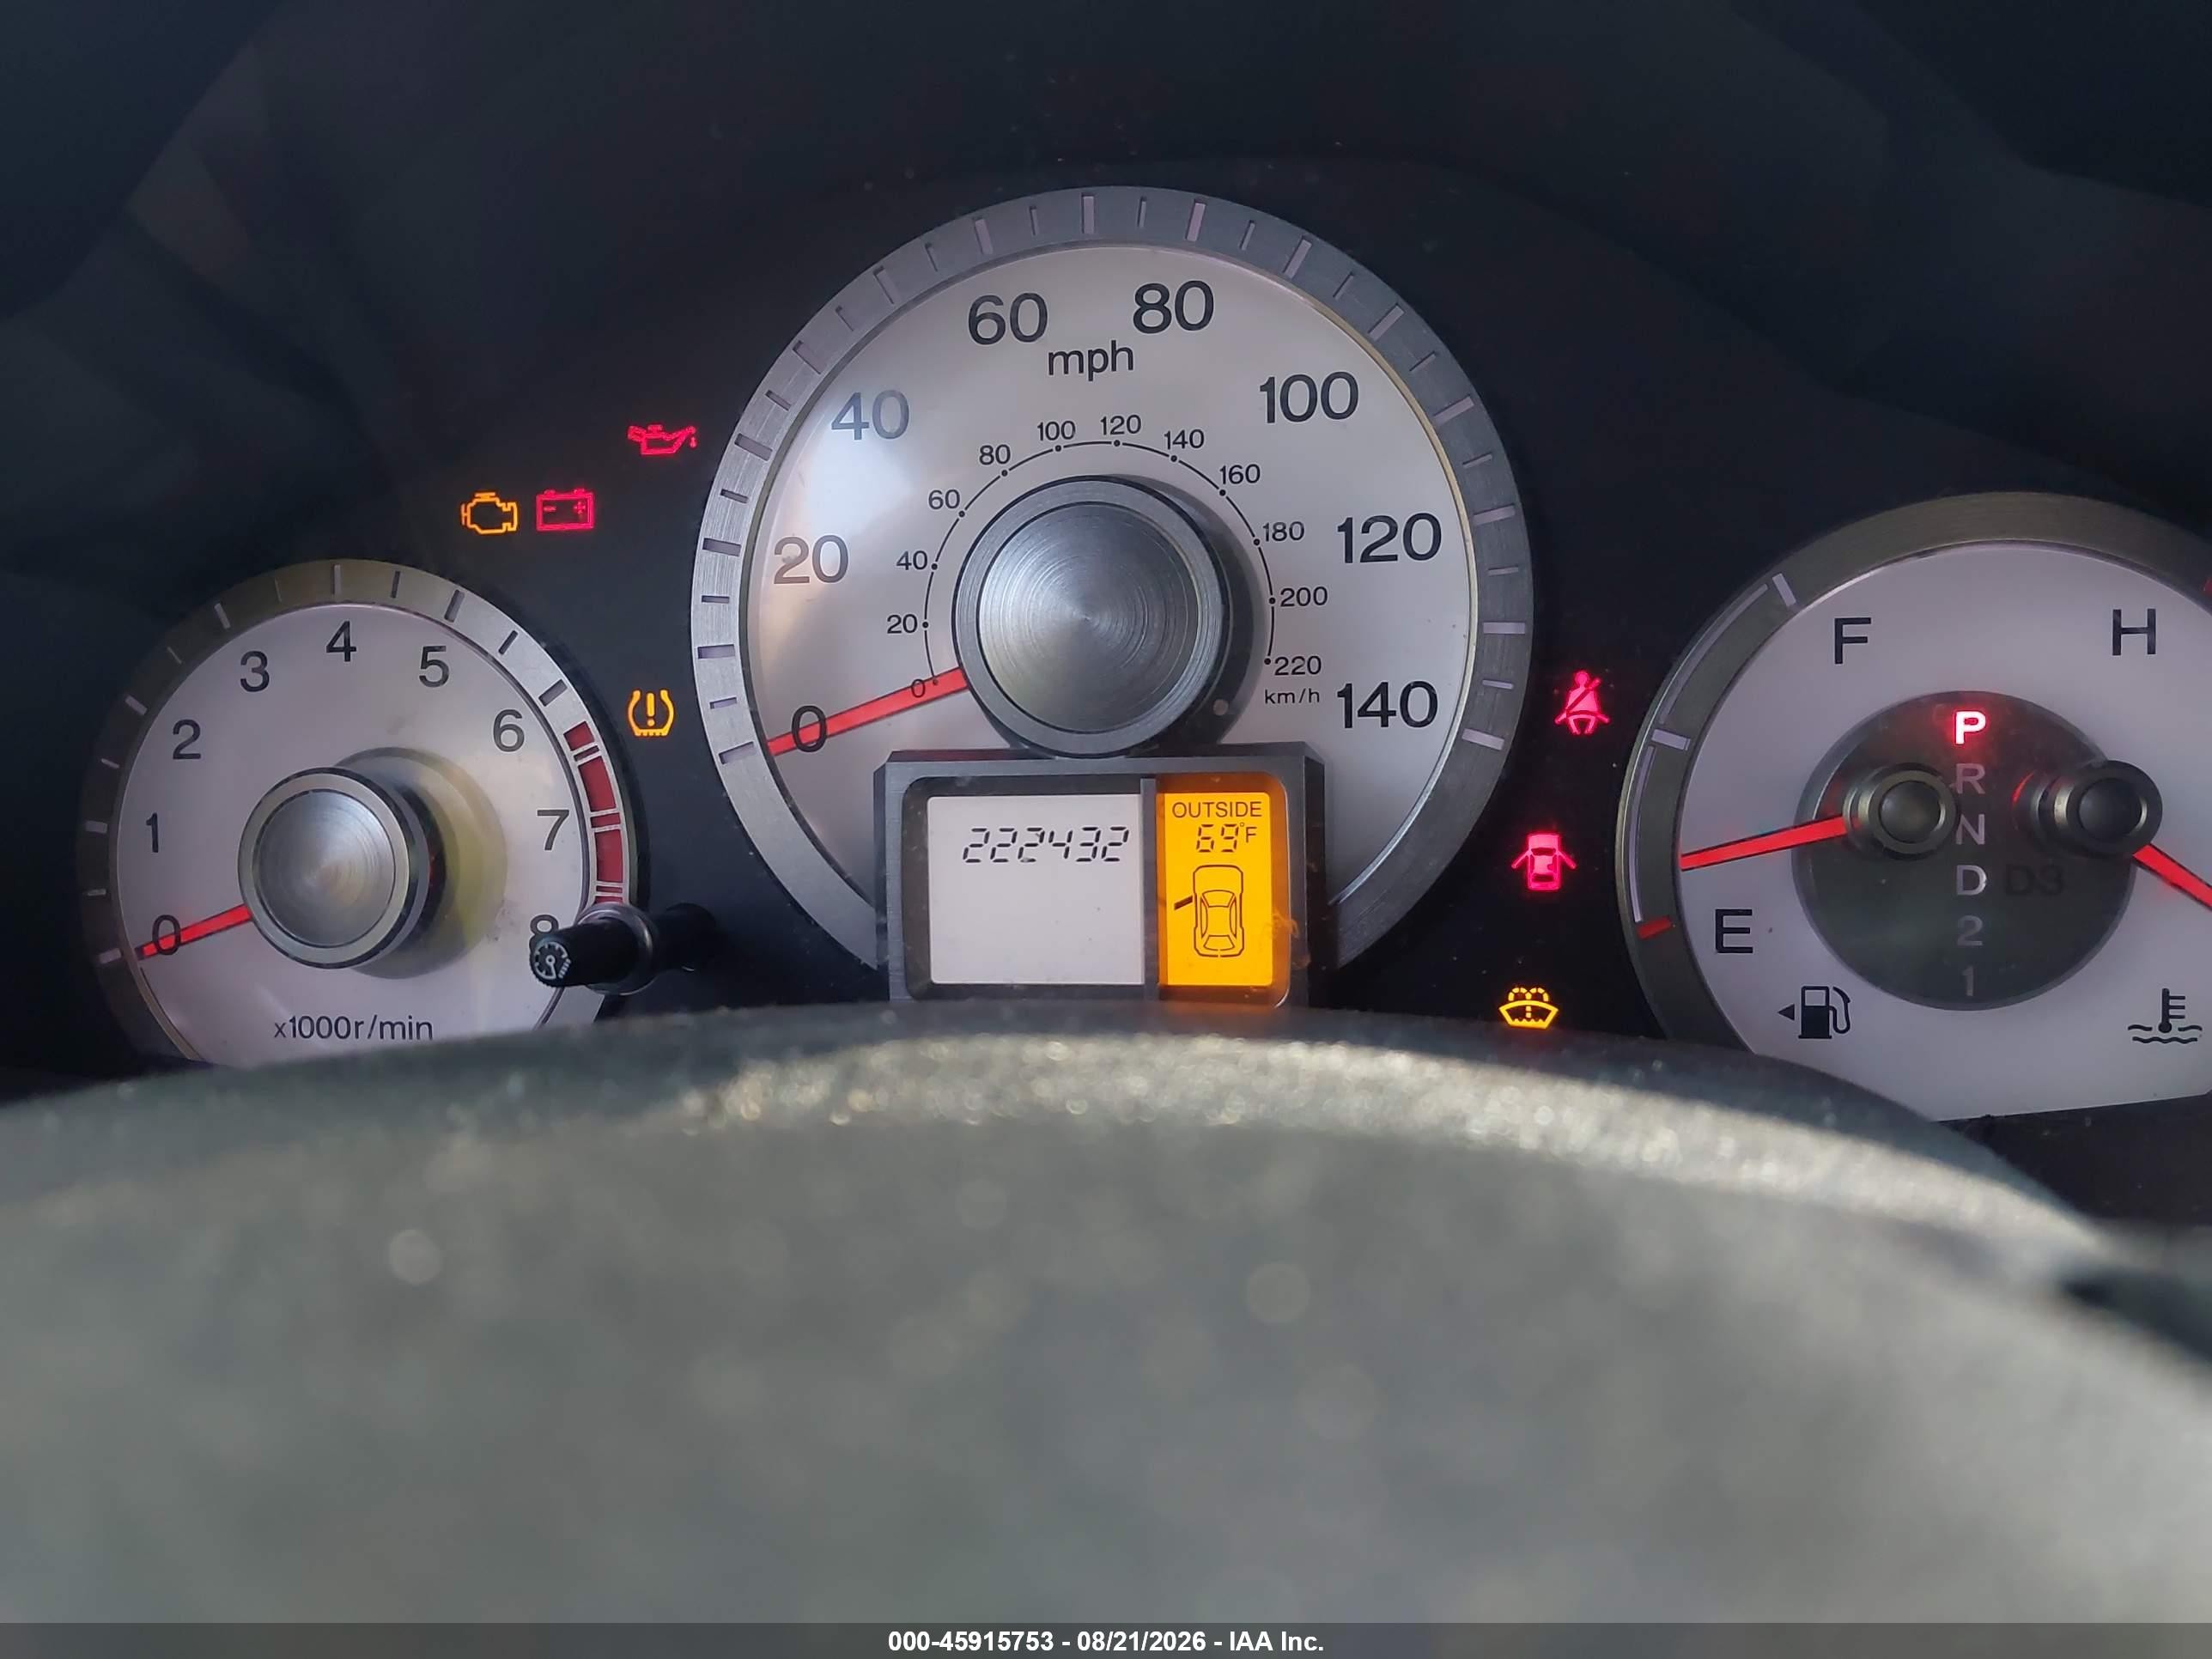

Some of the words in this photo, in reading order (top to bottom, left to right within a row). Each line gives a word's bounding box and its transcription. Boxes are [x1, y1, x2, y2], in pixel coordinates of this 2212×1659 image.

[967, 294, 1048, 343] 60
[1133, 281, 1214, 335] 80
[1048, 341, 1134, 381] mph
[1259, 372, 1359, 423] 100
[830, 391, 909, 441] 40
[1036, 420, 1076, 441] 100
[1099, 415, 1142, 436] 120
[979, 445, 1012, 466] 80
[1164, 429, 1205, 450] 140
[1218, 465, 1261, 485] 160
[927, 489, 960, 510] 60
[1262, 521, 1305, 542] 180
[1336, 514, 1443, 564] 120
[774, 537, 849, 584] 20
[896, 550, 928, 571] 40
[1279, 586, 1328, 606] 200
[886, 614, 919, 635] 20
[2112, 608, 2157, 656] H
[326, 621, 356, 661] 4
[1834, 617, 1872, 665] F
[240, 652, 270, 692] 3
[418, 646, 449, 687] 5
[1273, 656, 1322, 677] 220
[910, 678, 927, 699] 0
[1264, 686, 1322, 706] km/h
[1336, 683, 1438, 729] 140
[173, 720, 201, 760] 2
[493, 709, 524, 751] 6
[793, 706, 827, 752] 0
[1955, 712, 1987, 744] P
[1956, 764, 1985, 794] R
[1171, 801, 1262, 817] OUTSIDE
[146, 814, 159, 853] 1
[537, 810, 569, 850] 7
[963, 826, 1130, 863] 222432
[1957, 815, 1985, 845] N
[1957, 866, 1987, 896] D
[2005, 866, 2063, 895] D3
[152, 915, 181, 956] 0
[1716, 909, 1753, 954] E
[1957, 915, 1983, 946] 2
[1963, 966, 1974, 997] 1
[274, 1015, 434, 1041] x1000r/min
